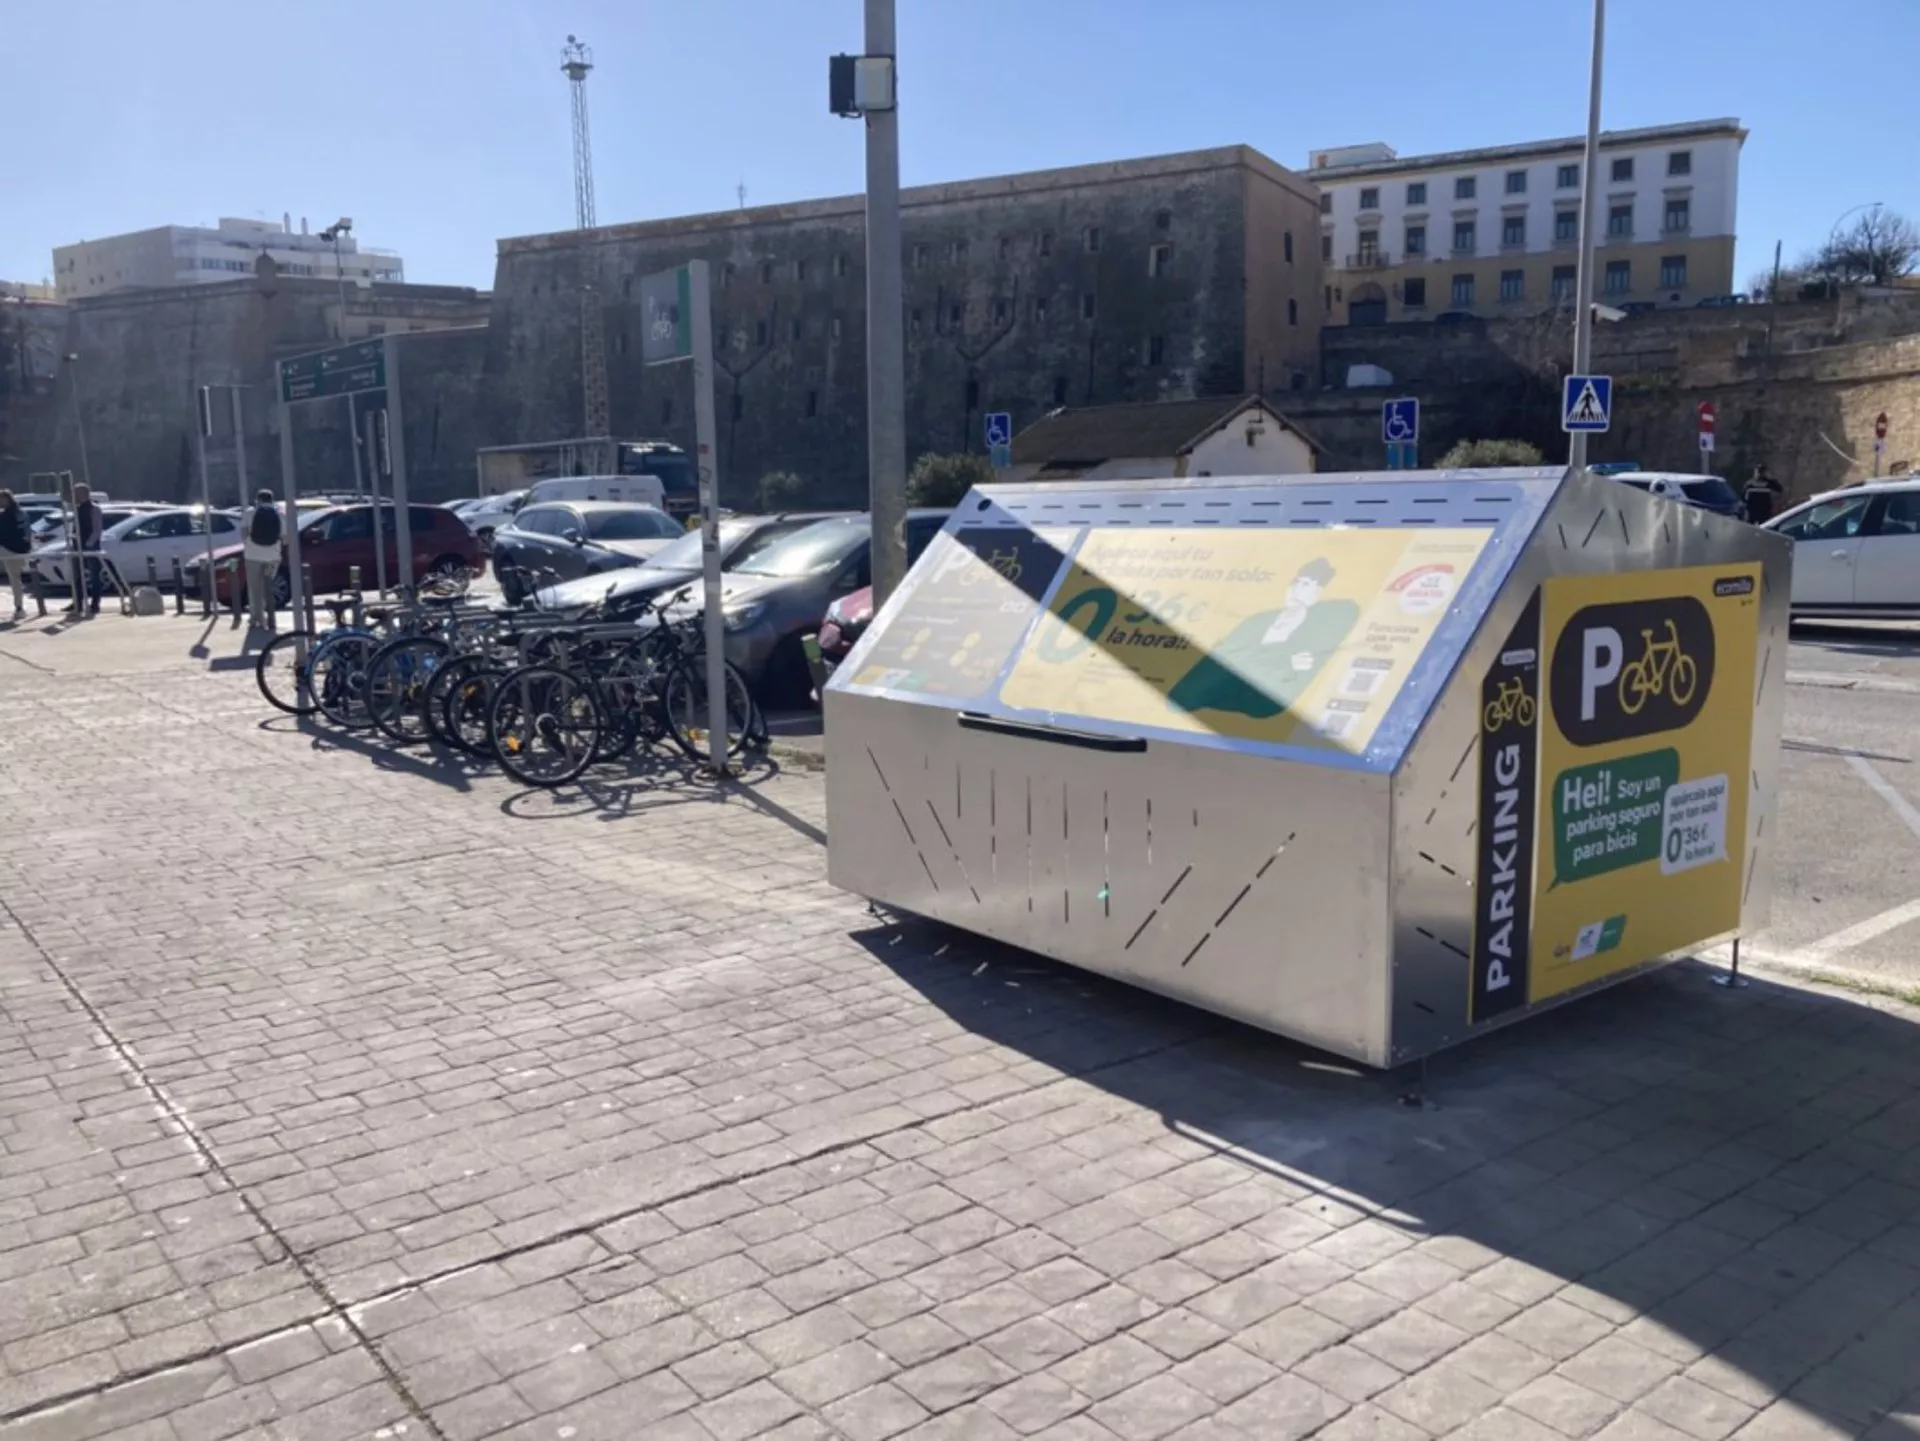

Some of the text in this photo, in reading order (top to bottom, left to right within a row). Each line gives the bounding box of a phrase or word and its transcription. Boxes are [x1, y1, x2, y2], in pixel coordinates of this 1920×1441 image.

[1106, 627, 1123, 645] la
[1580, 625, 1624, 722] P
[1562, 769, 1662, 814] Hei! Soy un
[1566, 801, 1662, 843] parking seguro
[1486, 743, 1521, 993] PARKING
[1572, 828, 1638, 867] para bicis
